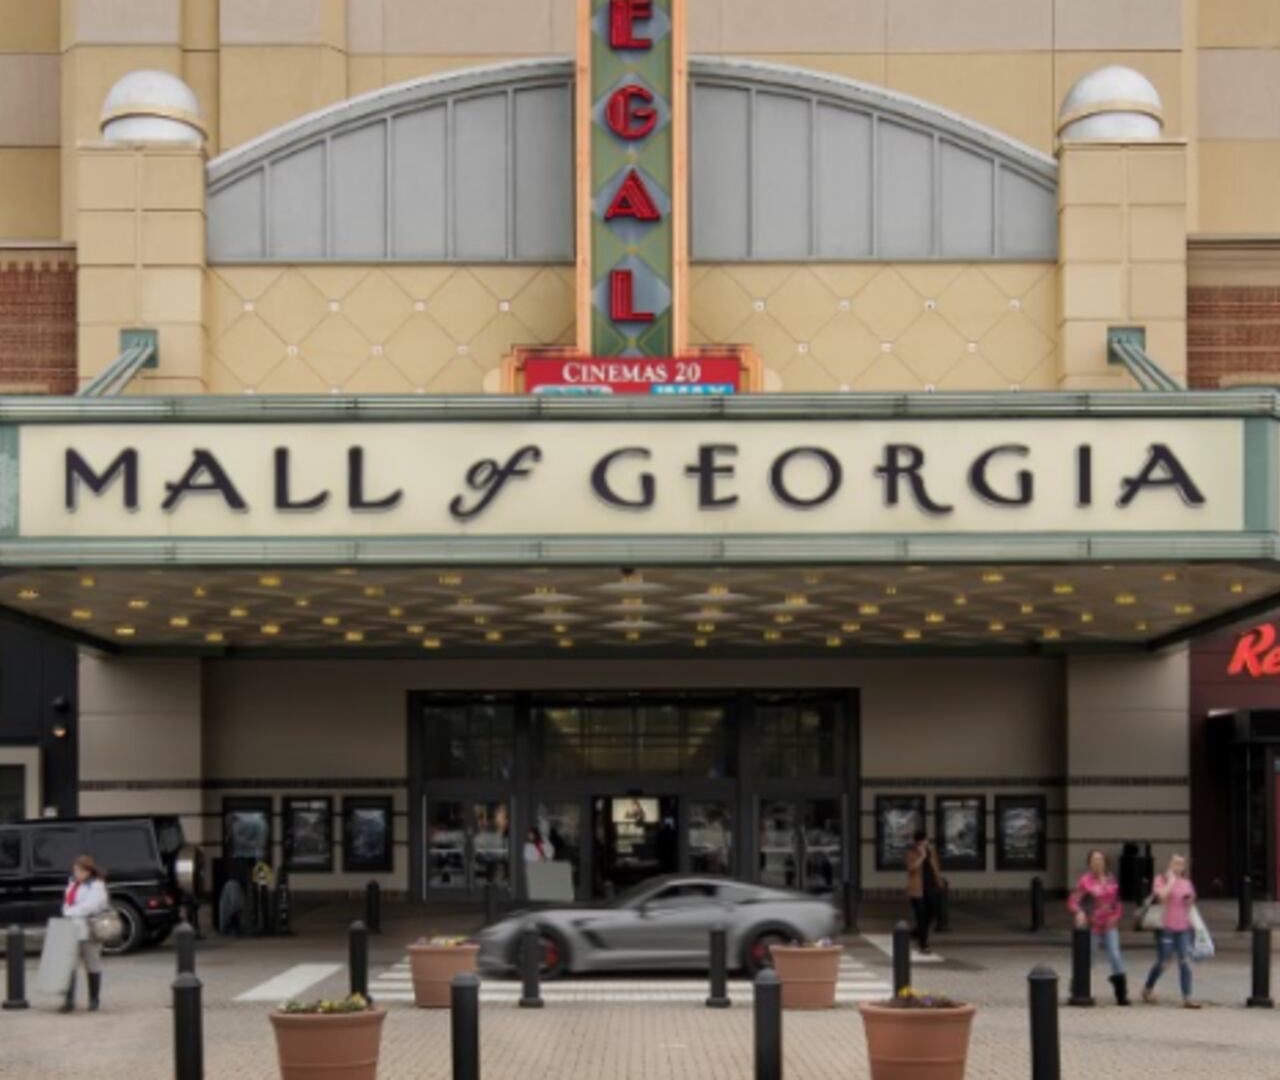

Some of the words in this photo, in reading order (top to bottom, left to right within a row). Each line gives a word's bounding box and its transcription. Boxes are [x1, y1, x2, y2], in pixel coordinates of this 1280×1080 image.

[561, 362, 668, 384] CINEMAS
[675, 362, 702, 383] 20
[64, 446, 404, 512] MALL
[449, 445, 542, 519] of
[589, 443, 1207, 515] GEORGIA
